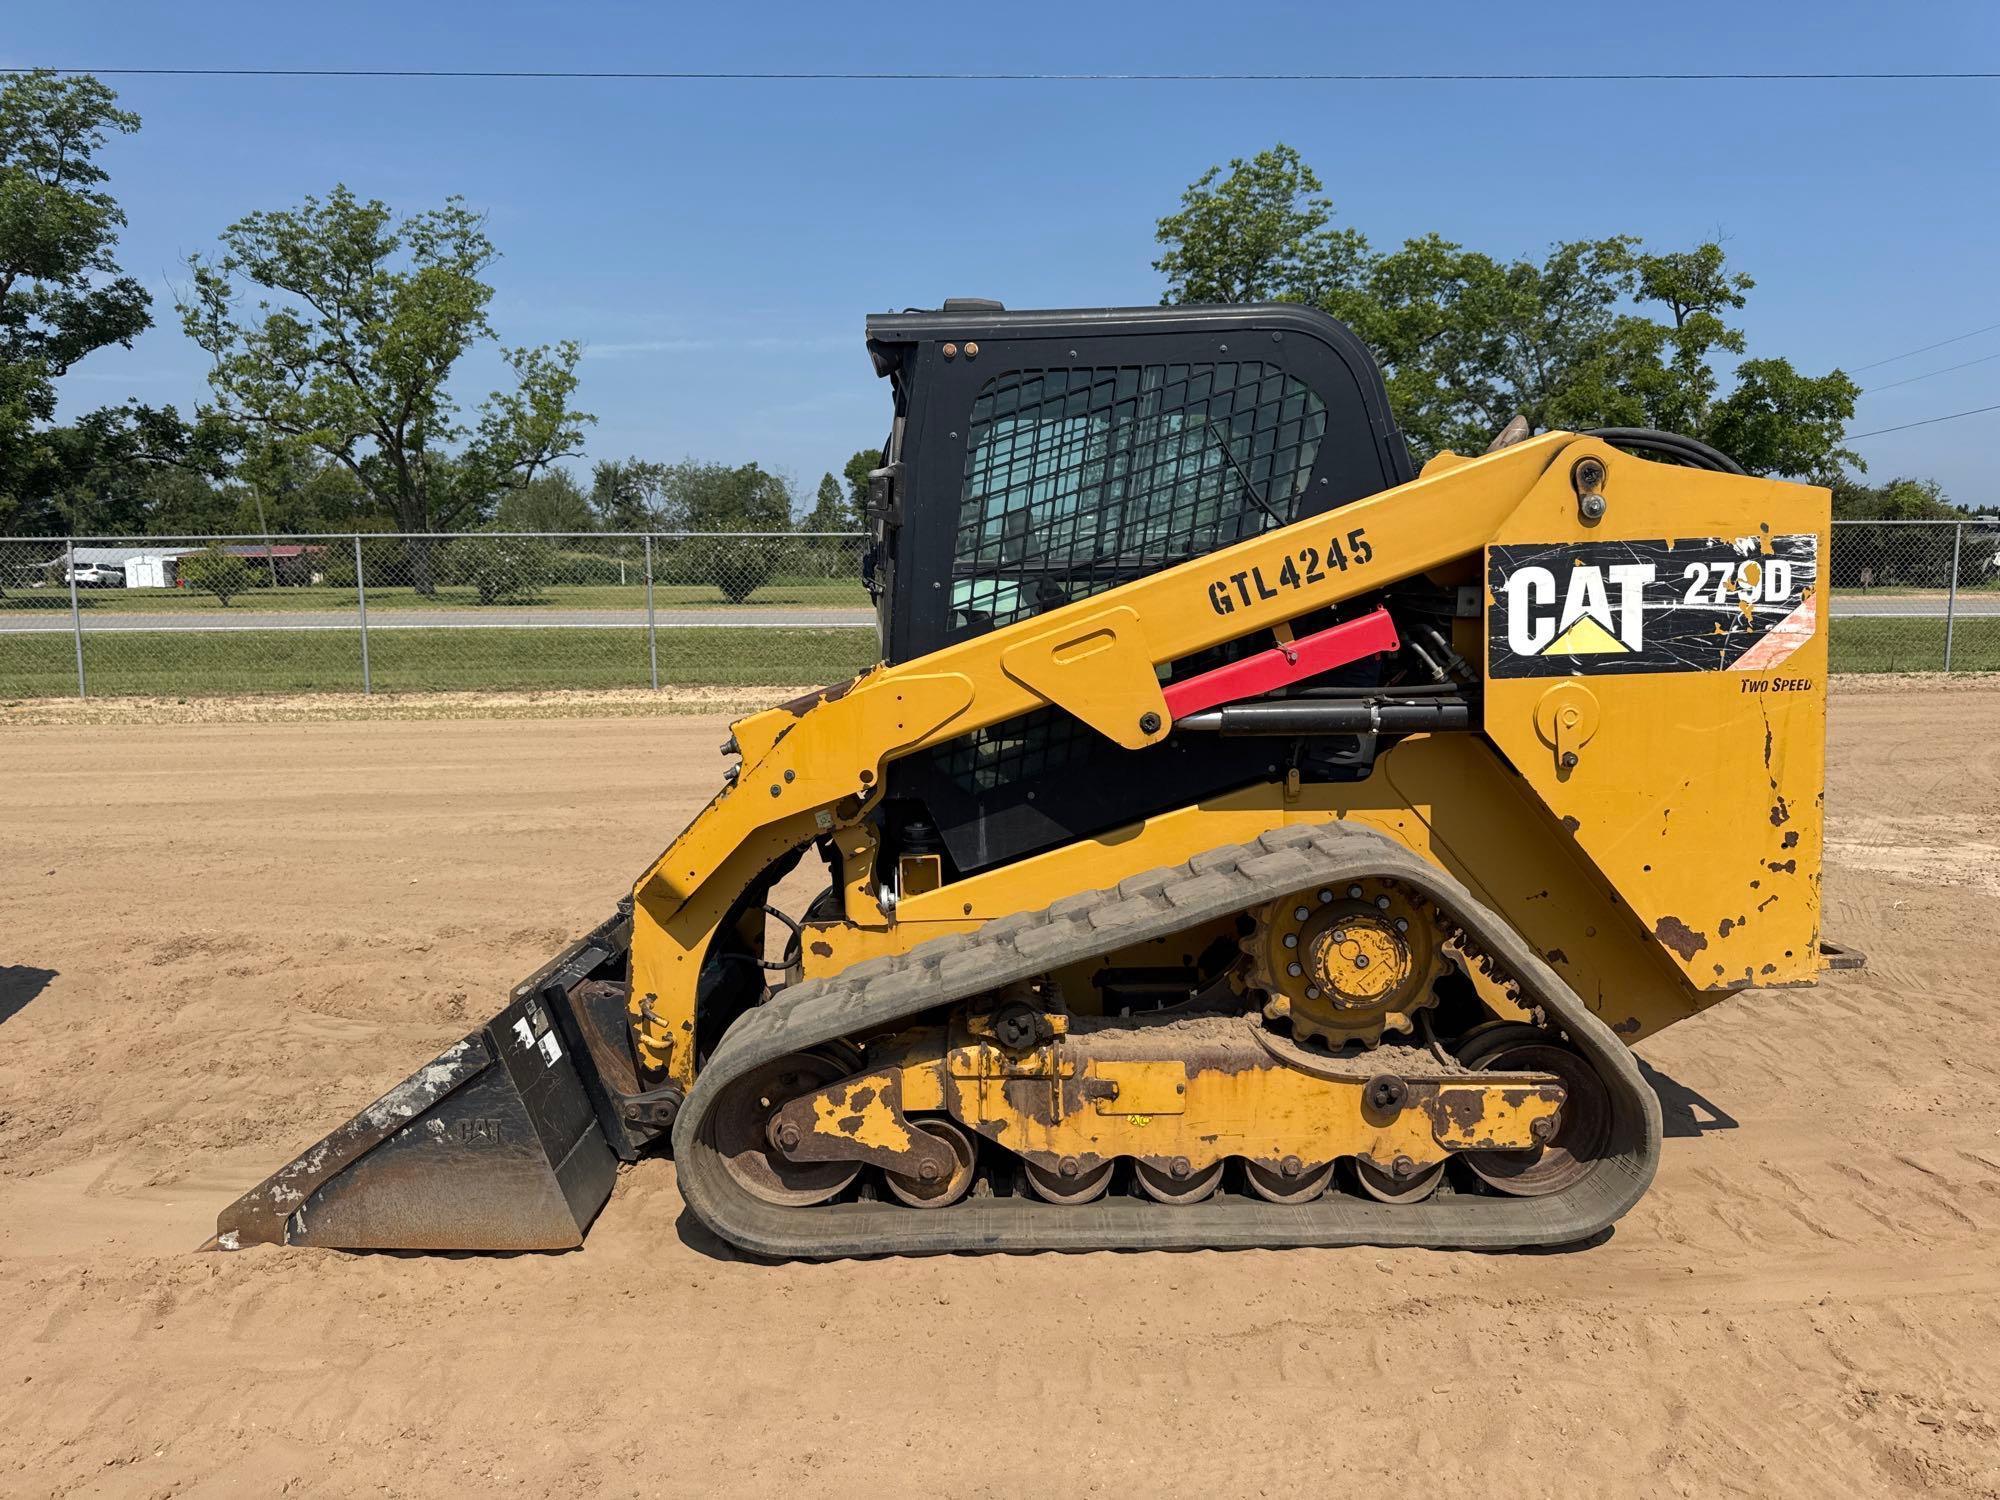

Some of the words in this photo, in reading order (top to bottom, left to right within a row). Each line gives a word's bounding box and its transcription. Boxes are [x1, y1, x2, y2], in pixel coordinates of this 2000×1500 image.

[1208, 528, 1373, 615] GTL4245
[1507, 563, 1656, 656] CAT
[1683, 560, 1792, 604] 279D
[456, 1118, 502, 1145] CAT
